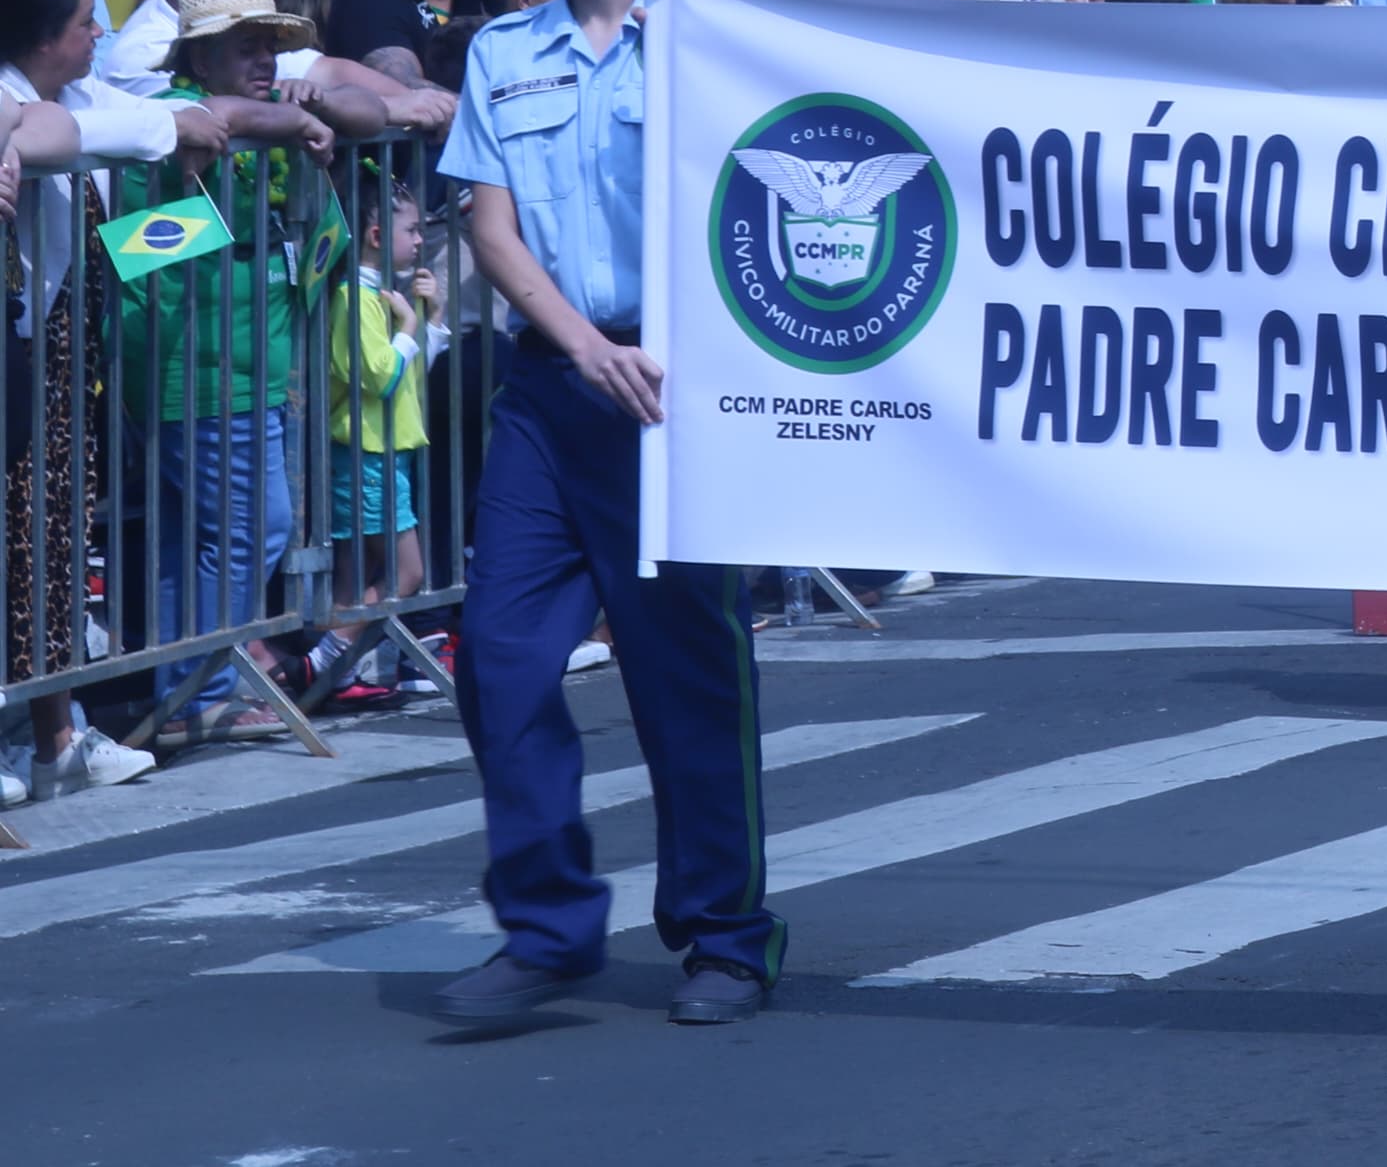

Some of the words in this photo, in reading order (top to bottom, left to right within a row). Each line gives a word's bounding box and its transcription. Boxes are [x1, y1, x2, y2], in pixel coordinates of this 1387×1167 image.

[790, 125, 876, 146] COLÉGIO
[980, 99, 1301, 276] COLÉGIO
[793, 241, 866, 260] CCMPR
[733, 219, 850, 348] CÍVICO-MILITAR
[853, 316, 883, 343] DO
[883, 223, 934, 323] PARANÁ
[978, 302, 1223, 449] PADRE
[718, 395, 766, 415] CCM
[772, 396, 844, 417] PADRE
[849, 398, 932, 420] CARLOS
[776, 421, 876, 442] ZELESNY
